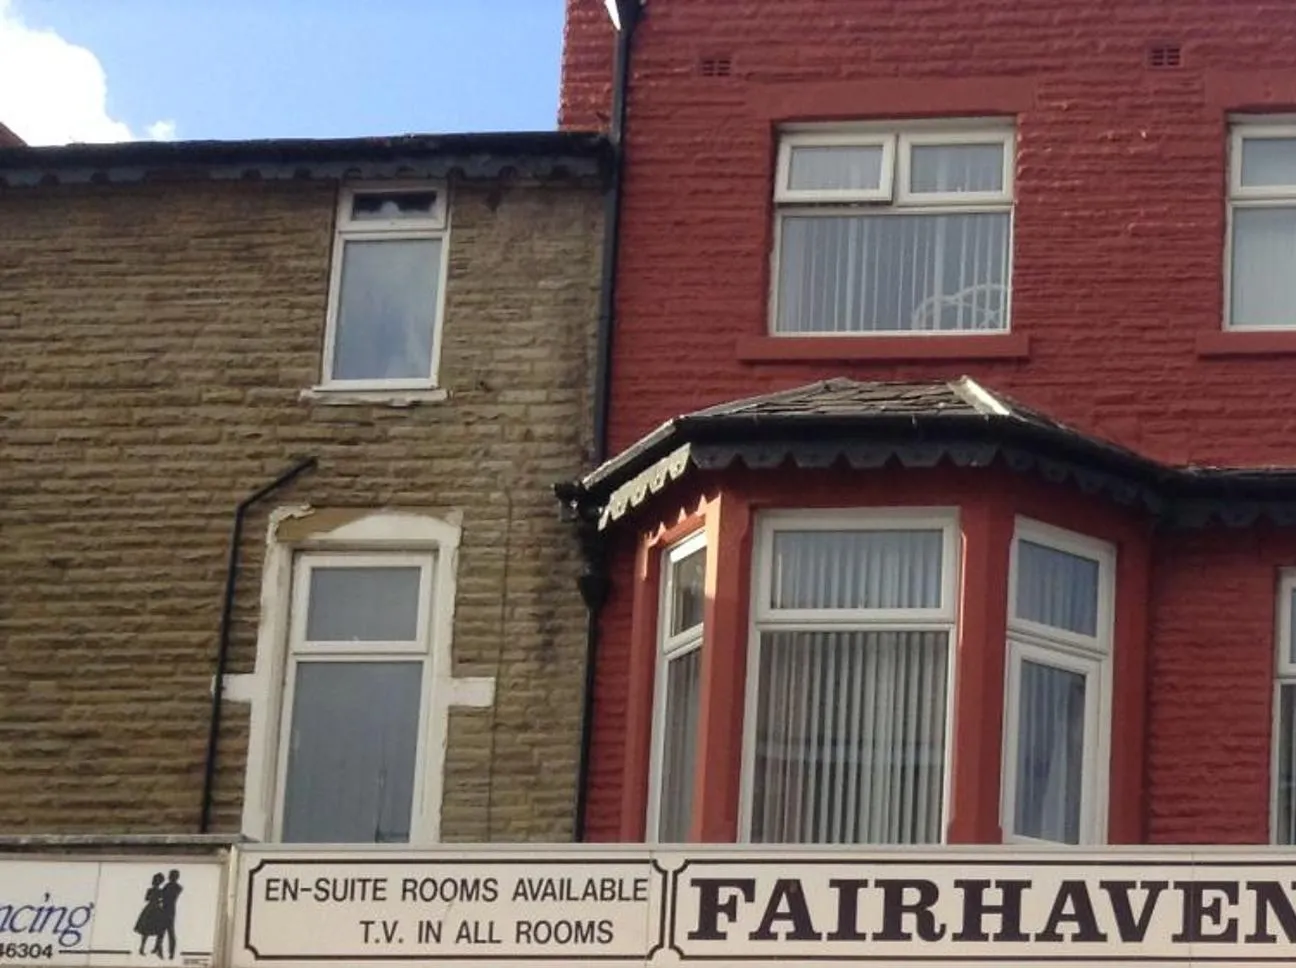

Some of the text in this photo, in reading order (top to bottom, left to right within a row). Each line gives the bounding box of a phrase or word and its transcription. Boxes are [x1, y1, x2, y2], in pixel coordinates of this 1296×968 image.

[265, 878, 648, 903] EN-SUITE ROOMS AVAILABLE
[360, 919, 614, 944] T.V. IN ALL ROOMS
